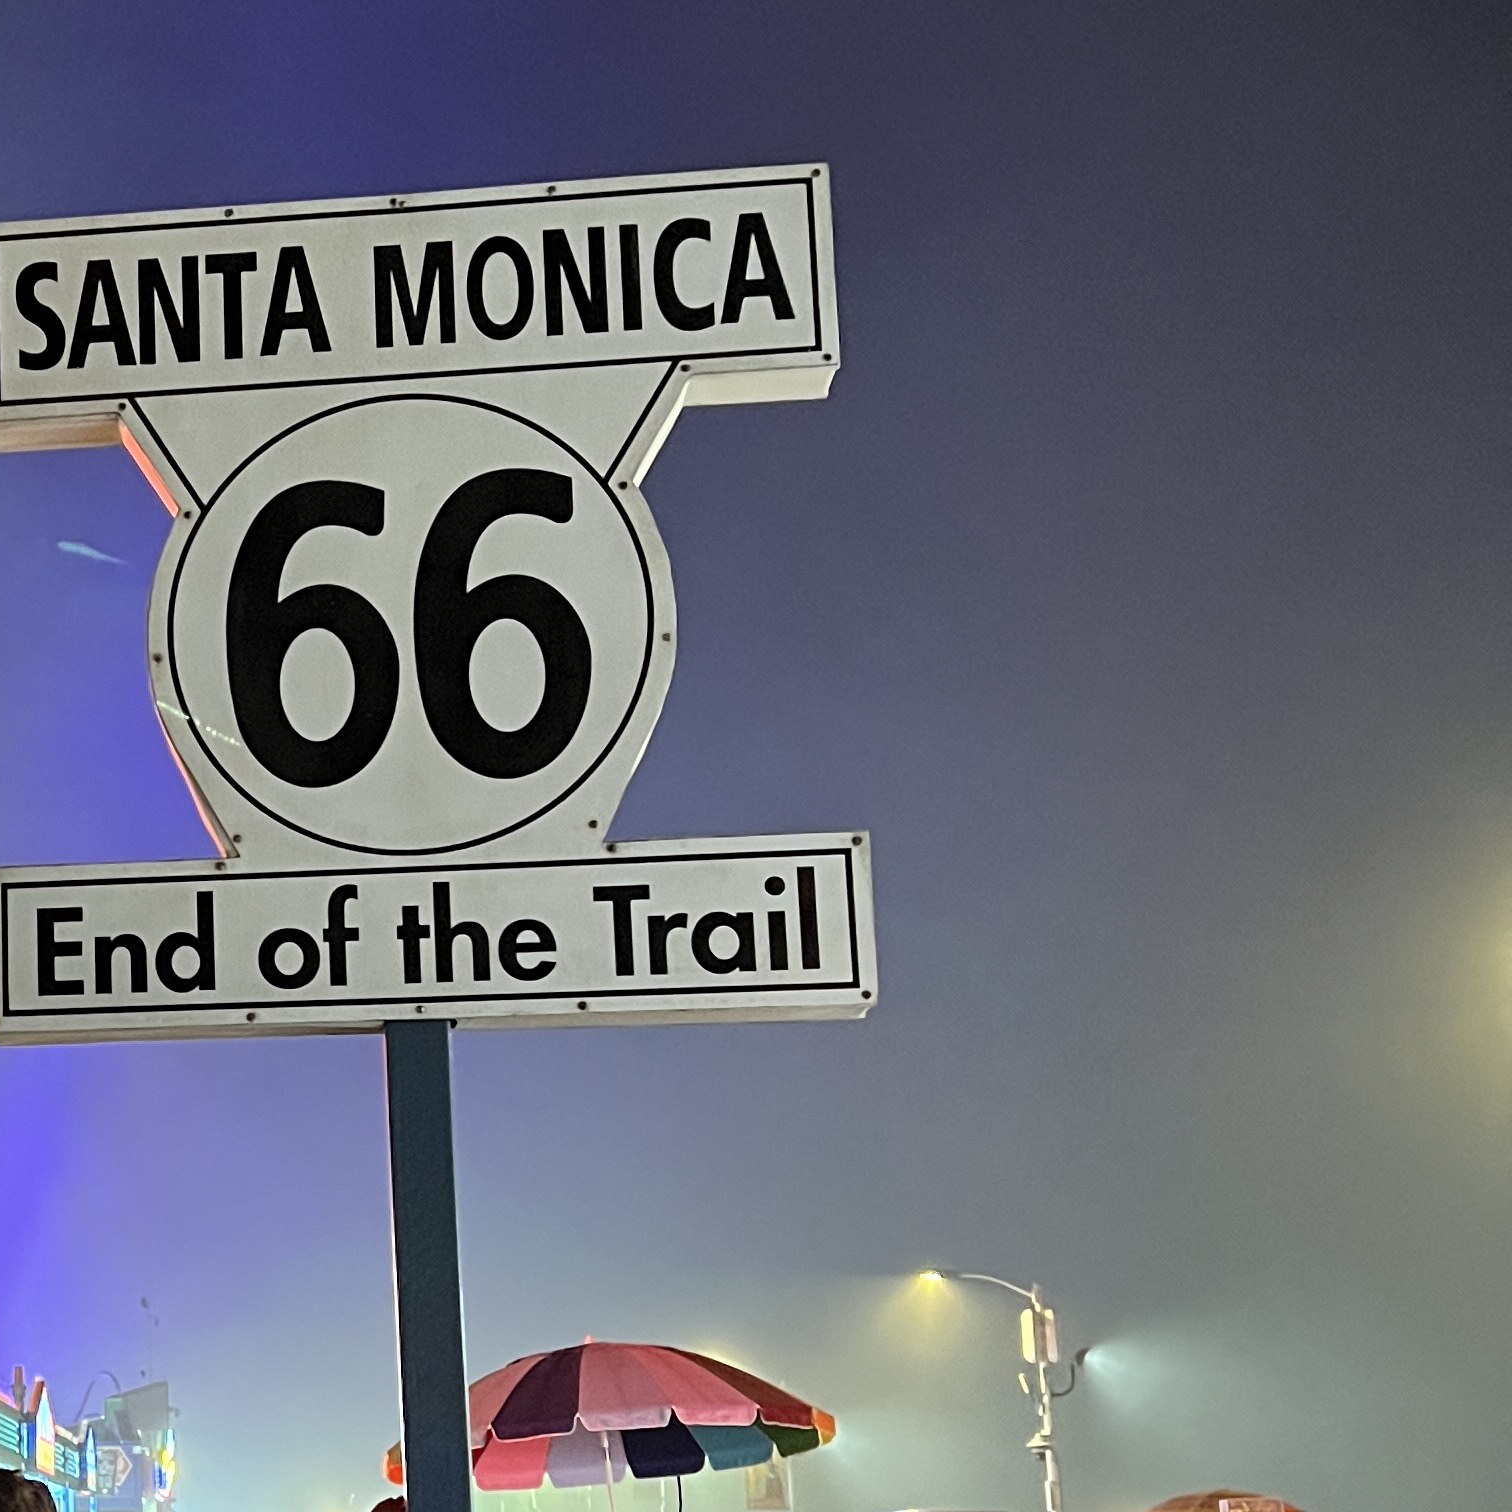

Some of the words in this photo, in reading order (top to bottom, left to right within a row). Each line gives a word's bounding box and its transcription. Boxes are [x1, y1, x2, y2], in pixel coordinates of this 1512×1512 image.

[16, 246, 331, 370] SANTA
[374, 213, 795, 348] MONICA
[226, 469, 591, 788] 66
[37, 891, 215, 997] End
[259, 885, 359, 989] of
[397, 882, 556, 984] the
[593, 867, 820, 976] Trail
